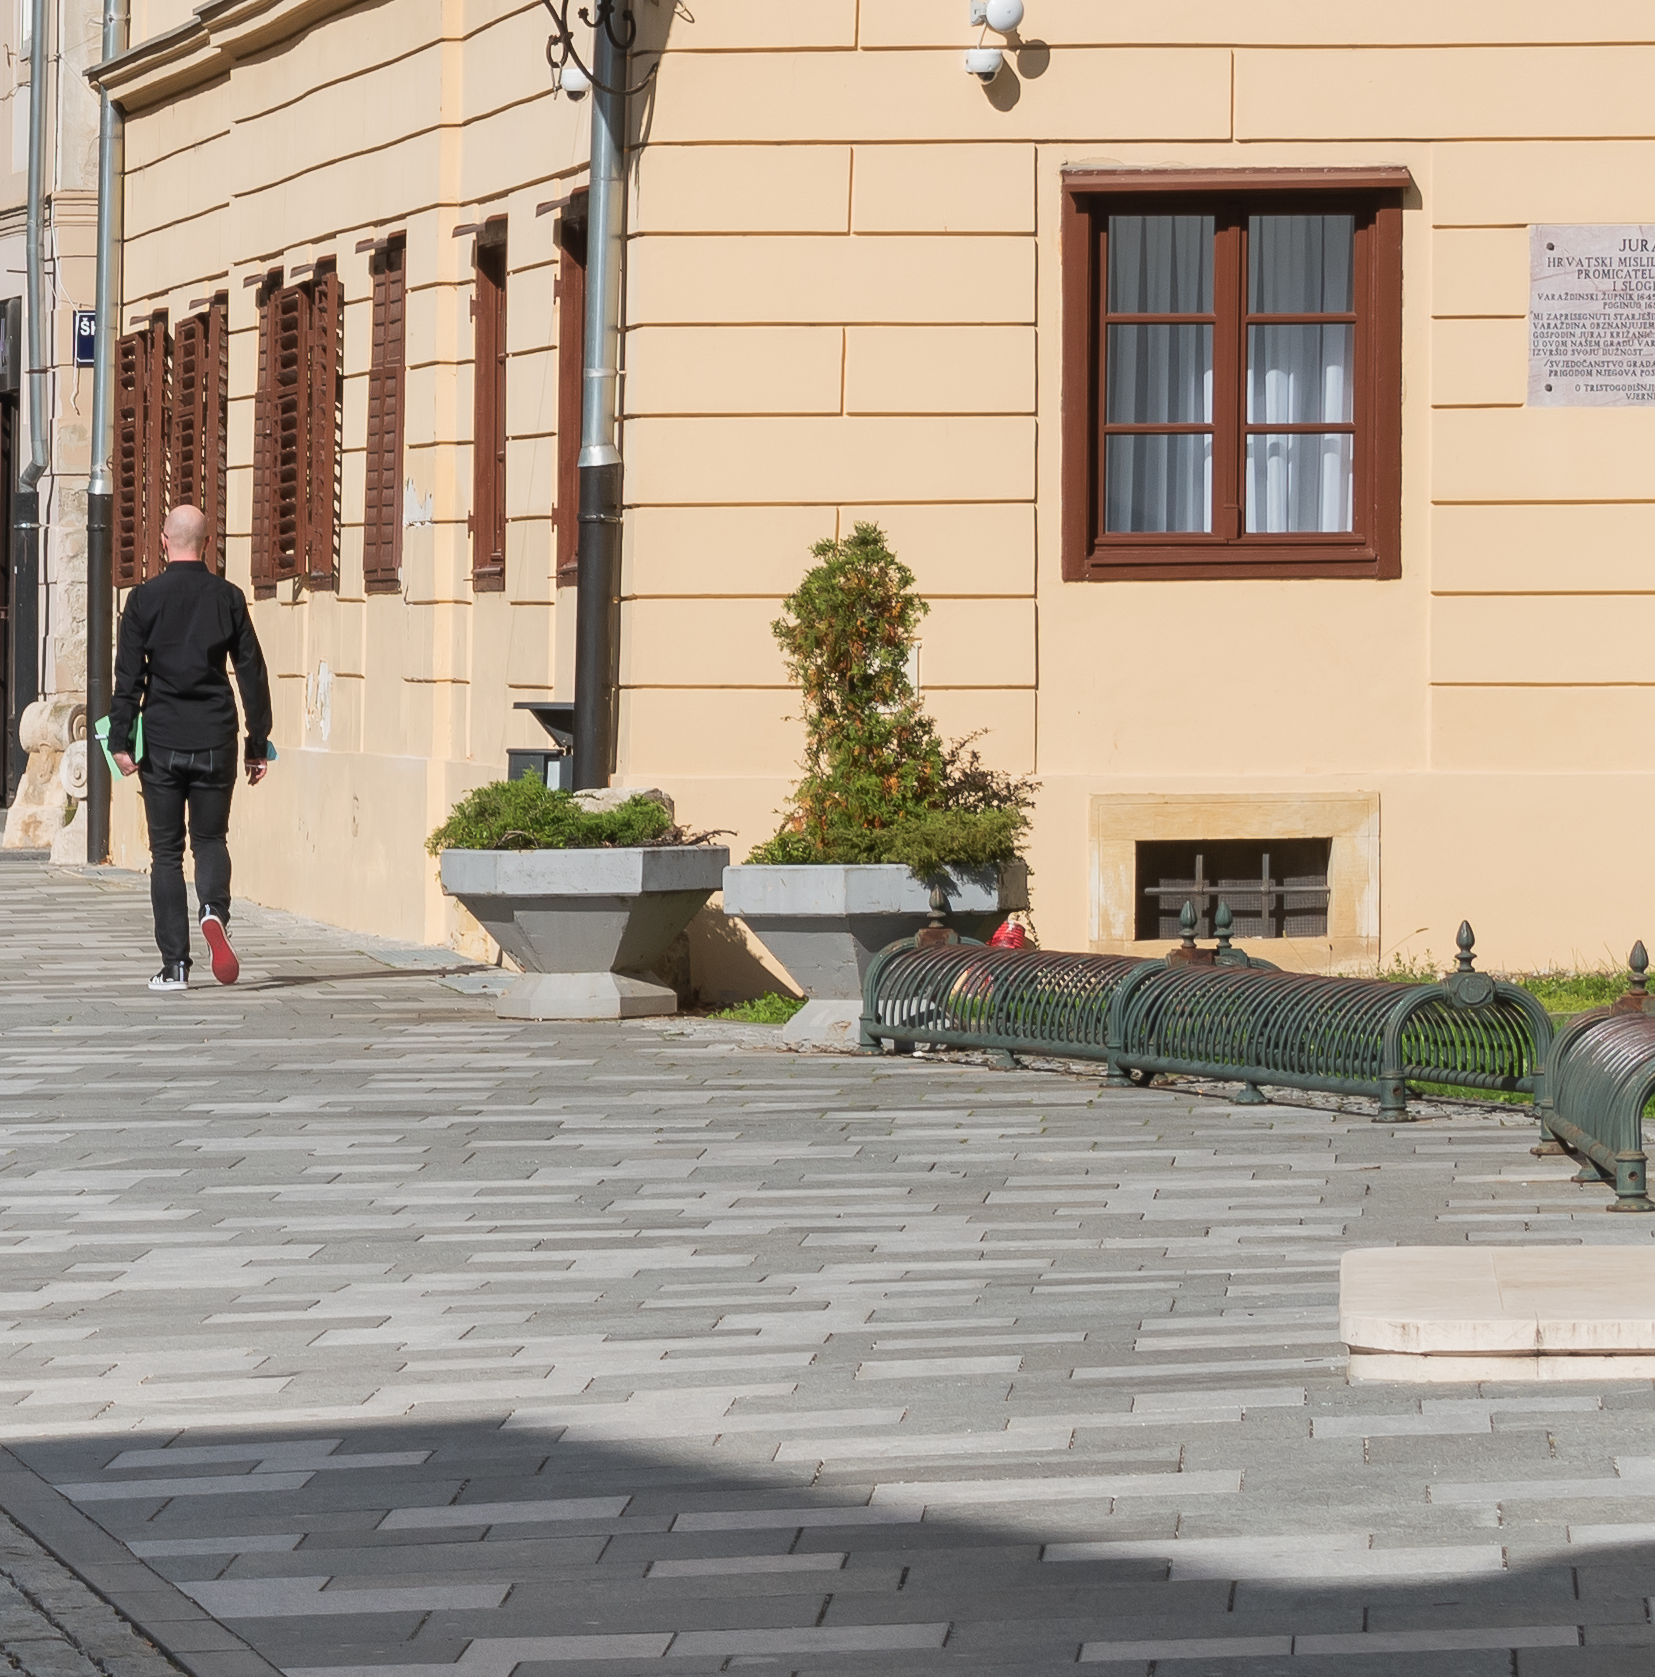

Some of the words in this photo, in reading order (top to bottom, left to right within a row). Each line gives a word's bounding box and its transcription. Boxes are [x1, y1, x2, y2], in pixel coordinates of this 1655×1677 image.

[1619, 238, 1655, 252] JUR
[1547, 256, 1613, 268] HRVATSKI
[1537, 291, 1599, 301] VARAŽDINSKI
[1601, 291, 1634, 301] ŽUPNIK
[1546, 312, 1611, 321] ZAPRISEGNUTI
[1532, 321, 1587, 330] VARAŽDINA
[1532, 331, 1576, 339] GOSPODIN
[1578, 331, 1607, 339] JURAJ
[1532, 340, 1540, 348] U
[1542, 340, 1568, 348] OVOM
[1570, 338, 1601, 348] NAŠEM
[1603, 340, 1634, 348] GRADU
[1532, 347, 1568, 356] IZVRŠIO
[1570, 348, 1600, 356] SVOJU
[1548, 369, 1593, 377] PRIGODOM
[1595, 369, 1637, 377] NJEGOVA
